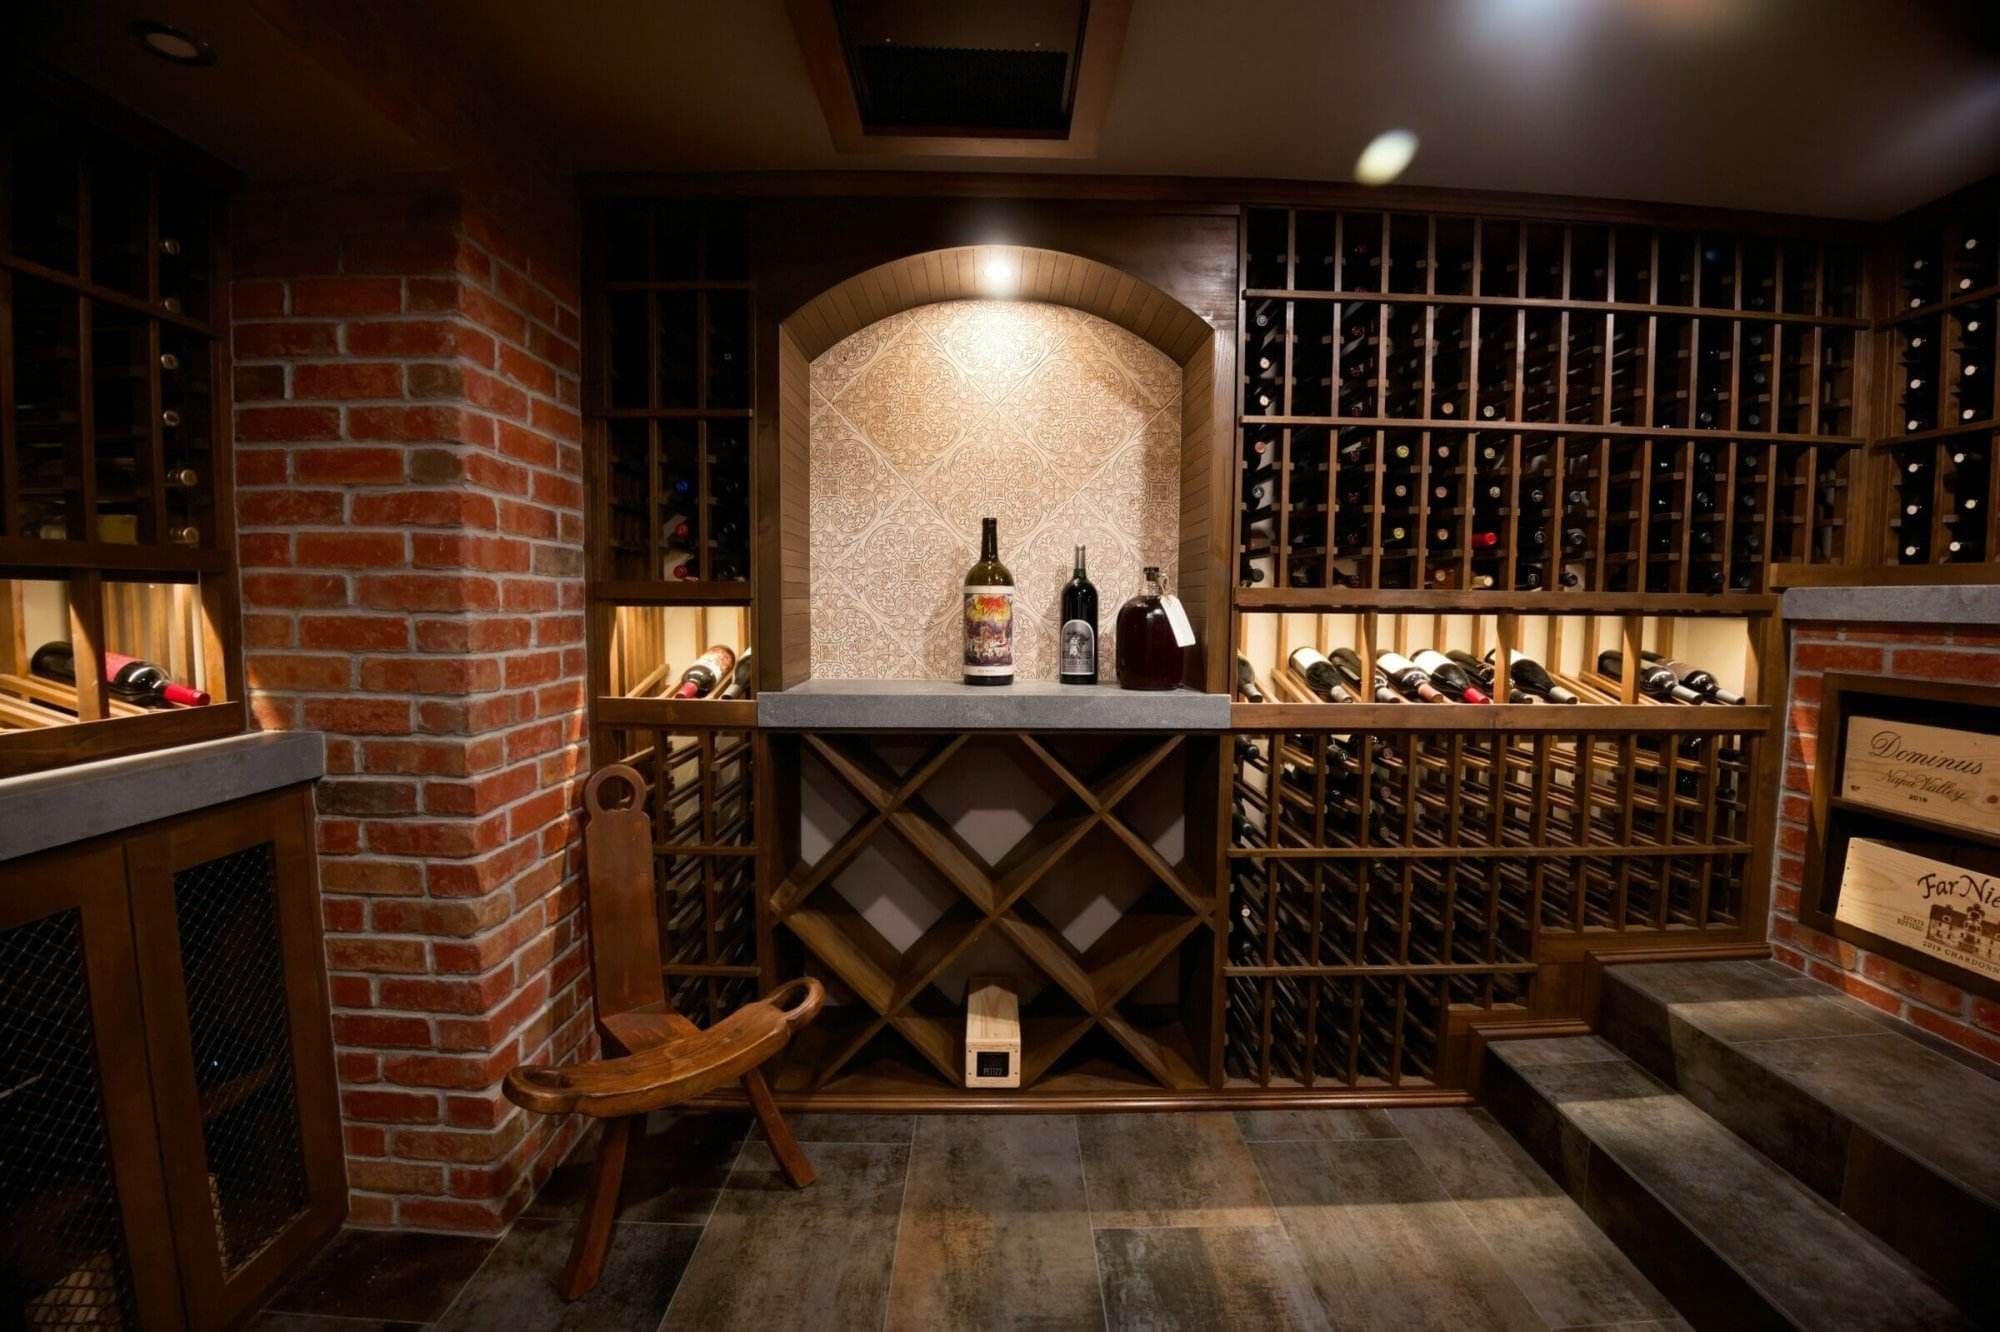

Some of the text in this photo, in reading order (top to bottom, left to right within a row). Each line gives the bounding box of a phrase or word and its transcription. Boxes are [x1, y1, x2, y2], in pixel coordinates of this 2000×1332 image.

[1868, 730, 1983, 775] Dominus
[1880, 769, 1968, 803] Napa Valley
[1917, 873, 1959, 899] Far
